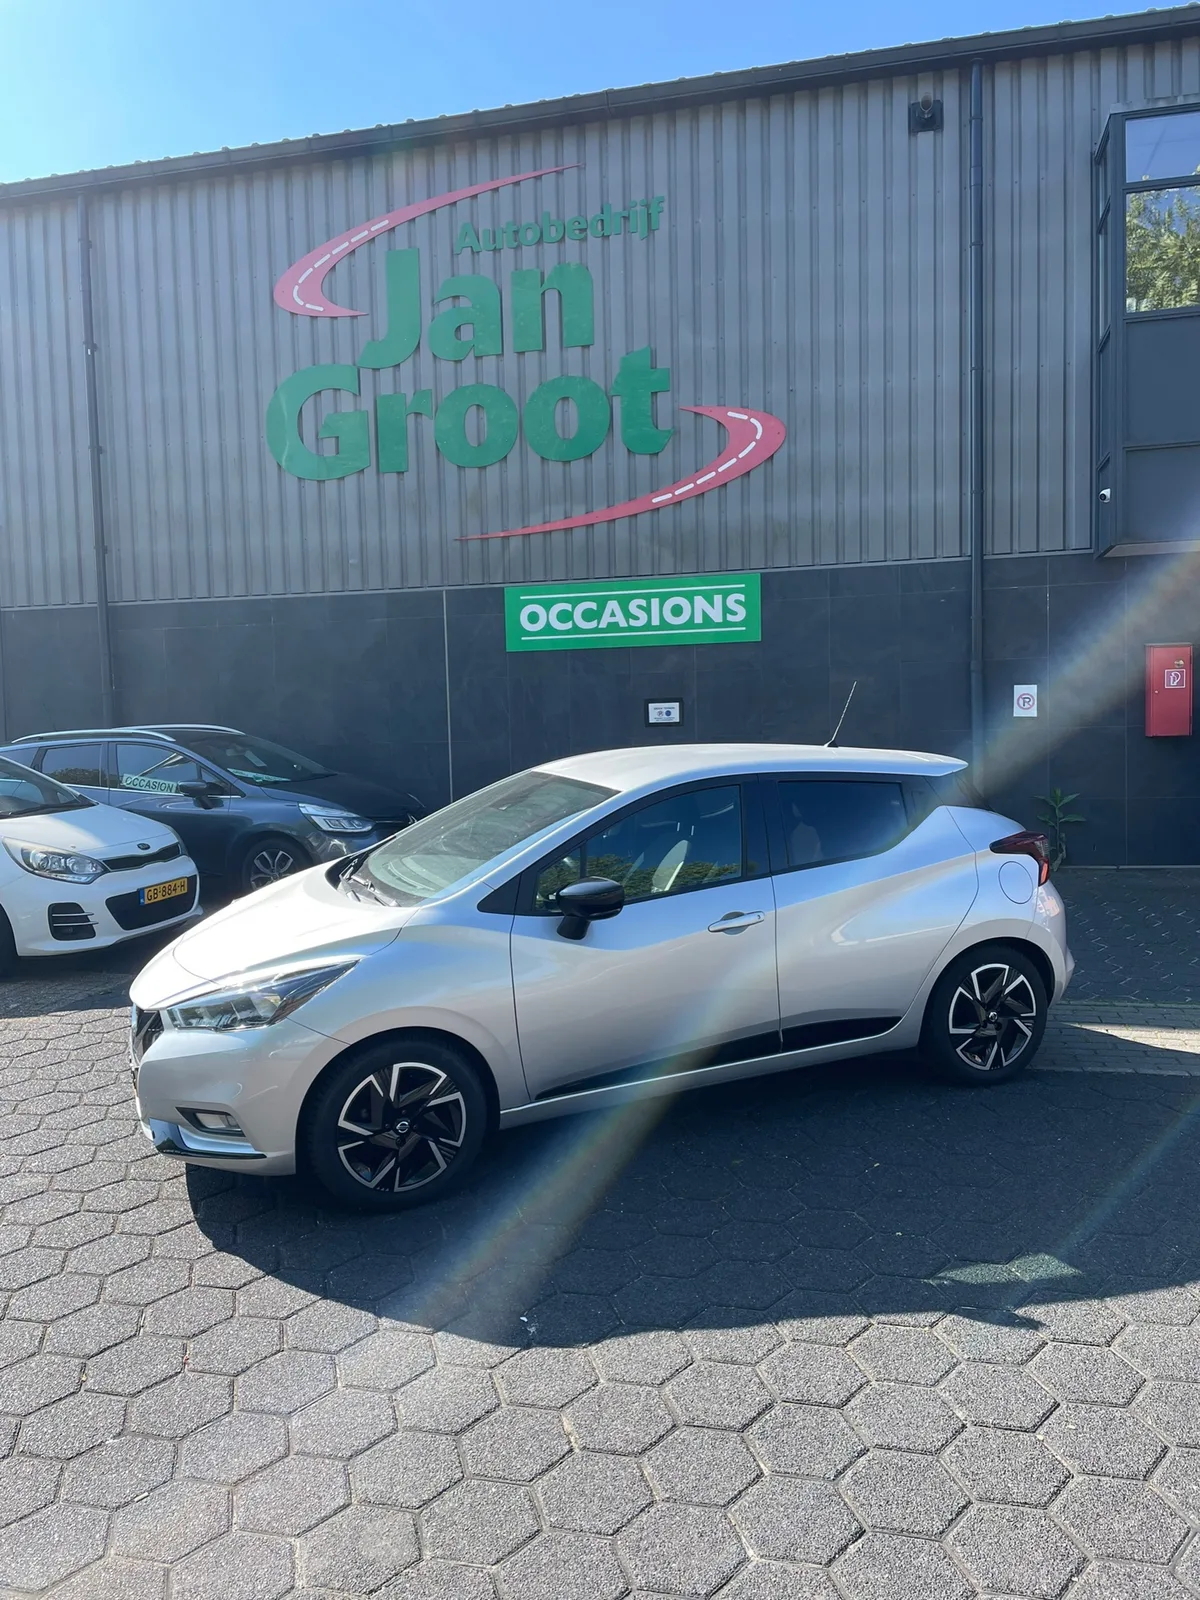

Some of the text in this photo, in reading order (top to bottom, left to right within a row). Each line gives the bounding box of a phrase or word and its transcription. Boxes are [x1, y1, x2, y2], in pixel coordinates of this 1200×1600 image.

[454, 196, 665, 255] Autobedrijf
[356, 247, 595, 370] Jan
[265, 346, 675, 481] Groot
[519, 593, 747, 632] OCCASIONS
[125, 776, 174, 793] OCCASION
[146, 880, 186, 901] GB-884-H
